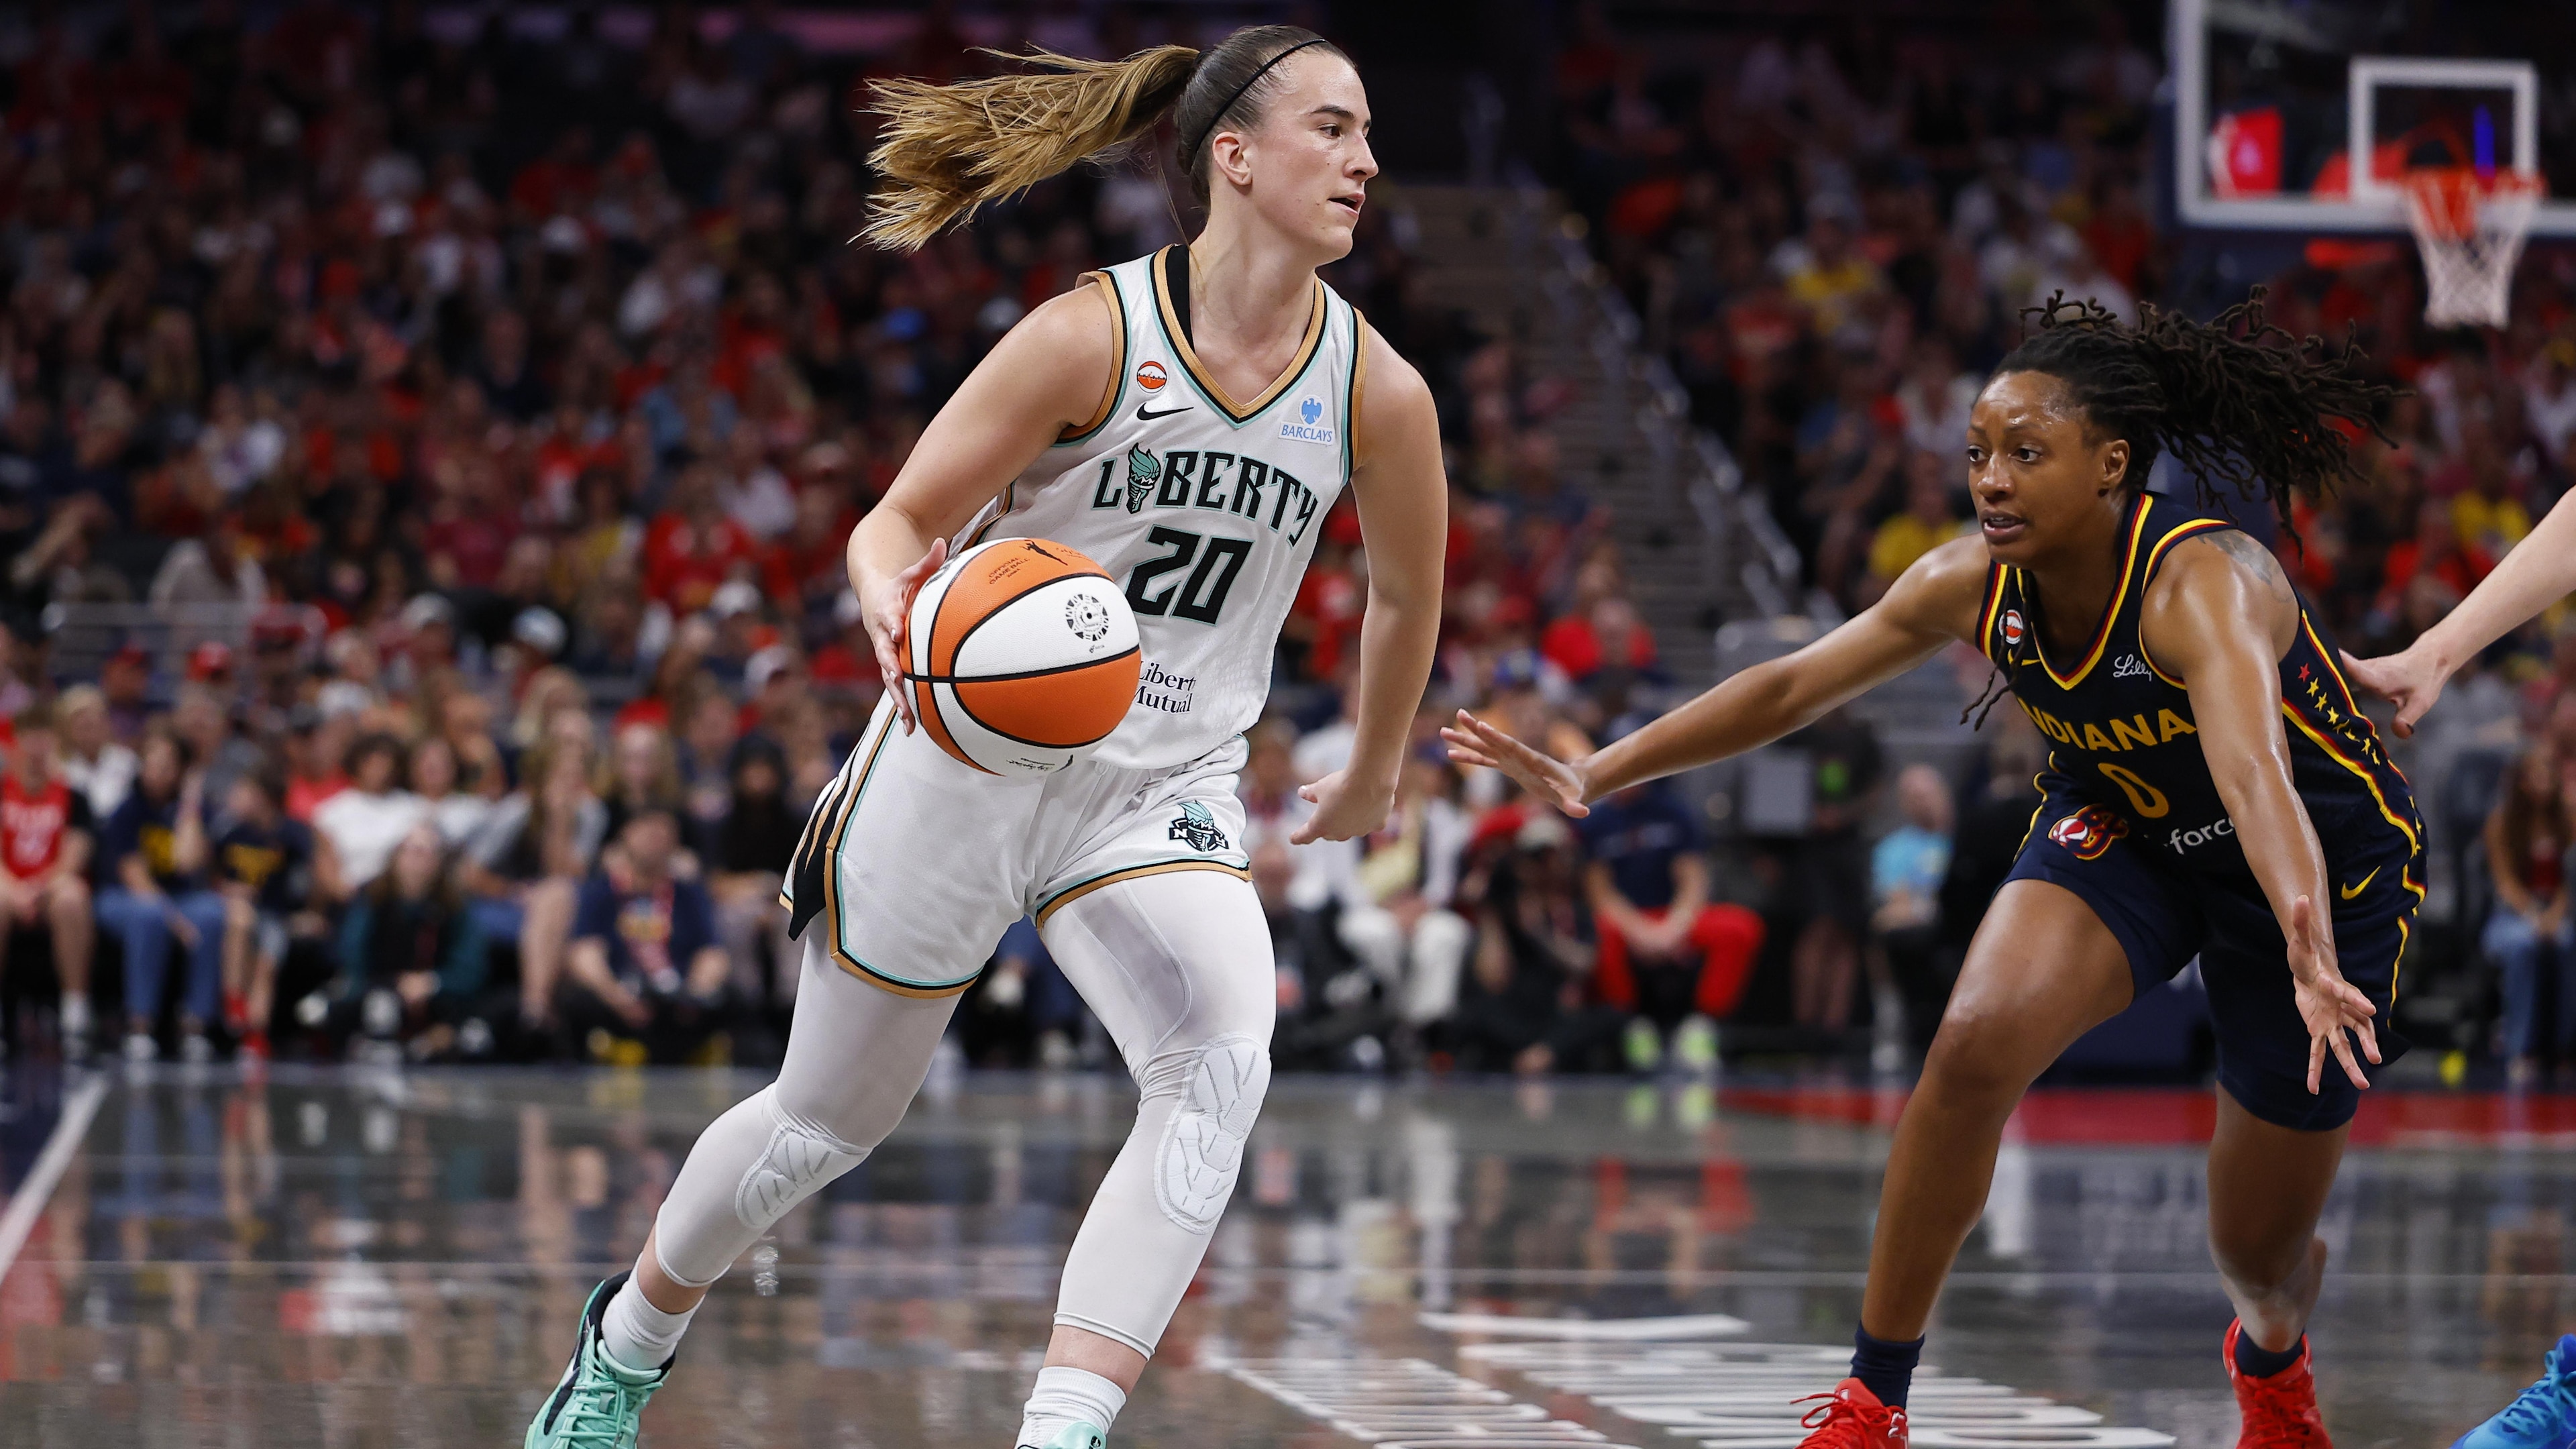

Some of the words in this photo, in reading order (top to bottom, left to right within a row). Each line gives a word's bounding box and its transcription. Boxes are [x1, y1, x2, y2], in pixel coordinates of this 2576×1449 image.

[1281, 424, 1332, 442] BARCLAYS
[1124, 525, 1254, 627] 20
[1139, 661, 1197, 691] ibert
[2112, 653, 2152, 682] Lilly
[2017, 697, 2197, 752] NDIANA
[2098, 762, 2169, 818] 0
[2169, 816, 2235, 855] forc
